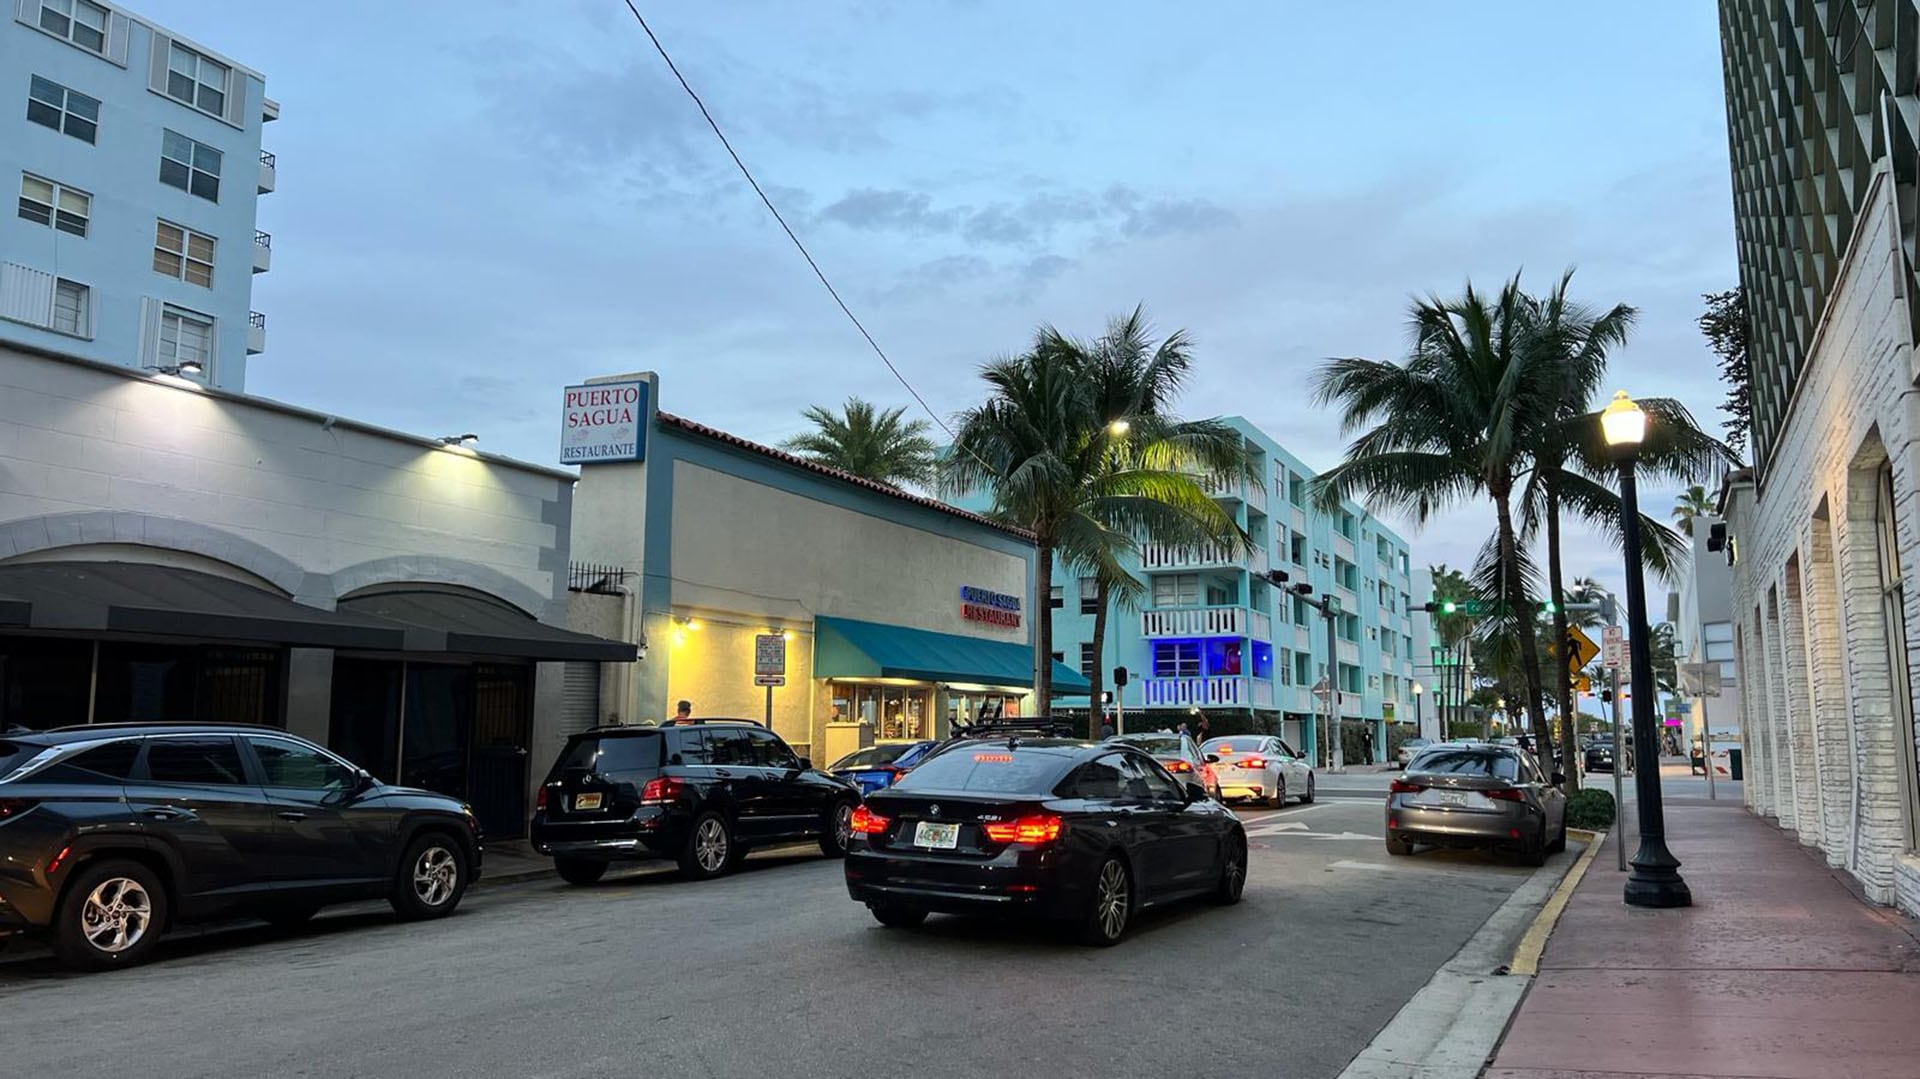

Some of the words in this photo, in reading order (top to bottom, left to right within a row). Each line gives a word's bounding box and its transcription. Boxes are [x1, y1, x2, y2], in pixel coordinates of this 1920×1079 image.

[567, 387, 638, 408] PUERTO
[568, 407, 632, 428] SAGUA
[563, 443, 635, 459] RESTAURANTE
[961, 604, 1021, 628] RESTAURANT
